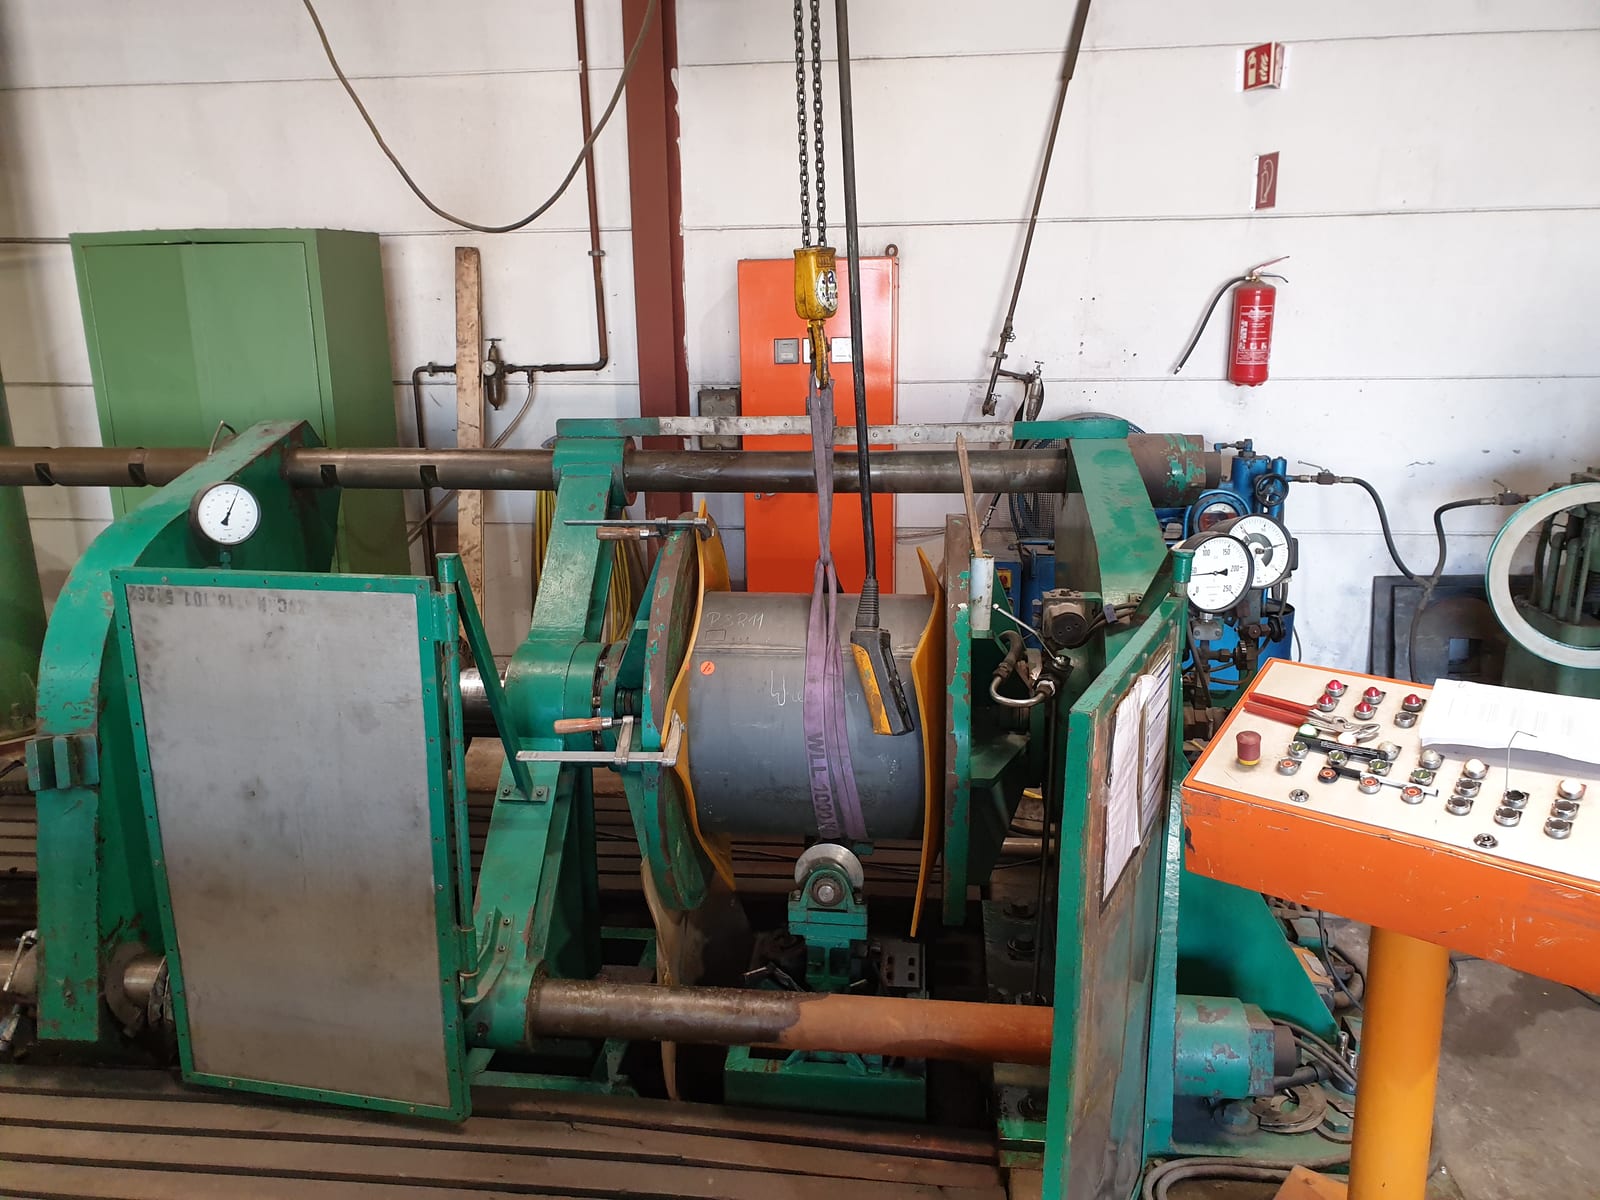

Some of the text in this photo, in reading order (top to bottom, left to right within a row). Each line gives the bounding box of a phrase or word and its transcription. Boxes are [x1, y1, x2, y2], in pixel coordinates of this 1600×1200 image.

[1203, 549, 1211, 557] 100
[1222, 548, 1231, 556] 150
[1223, 584, 1232, 593] 250
[807, 732, 827, 778] WLL
